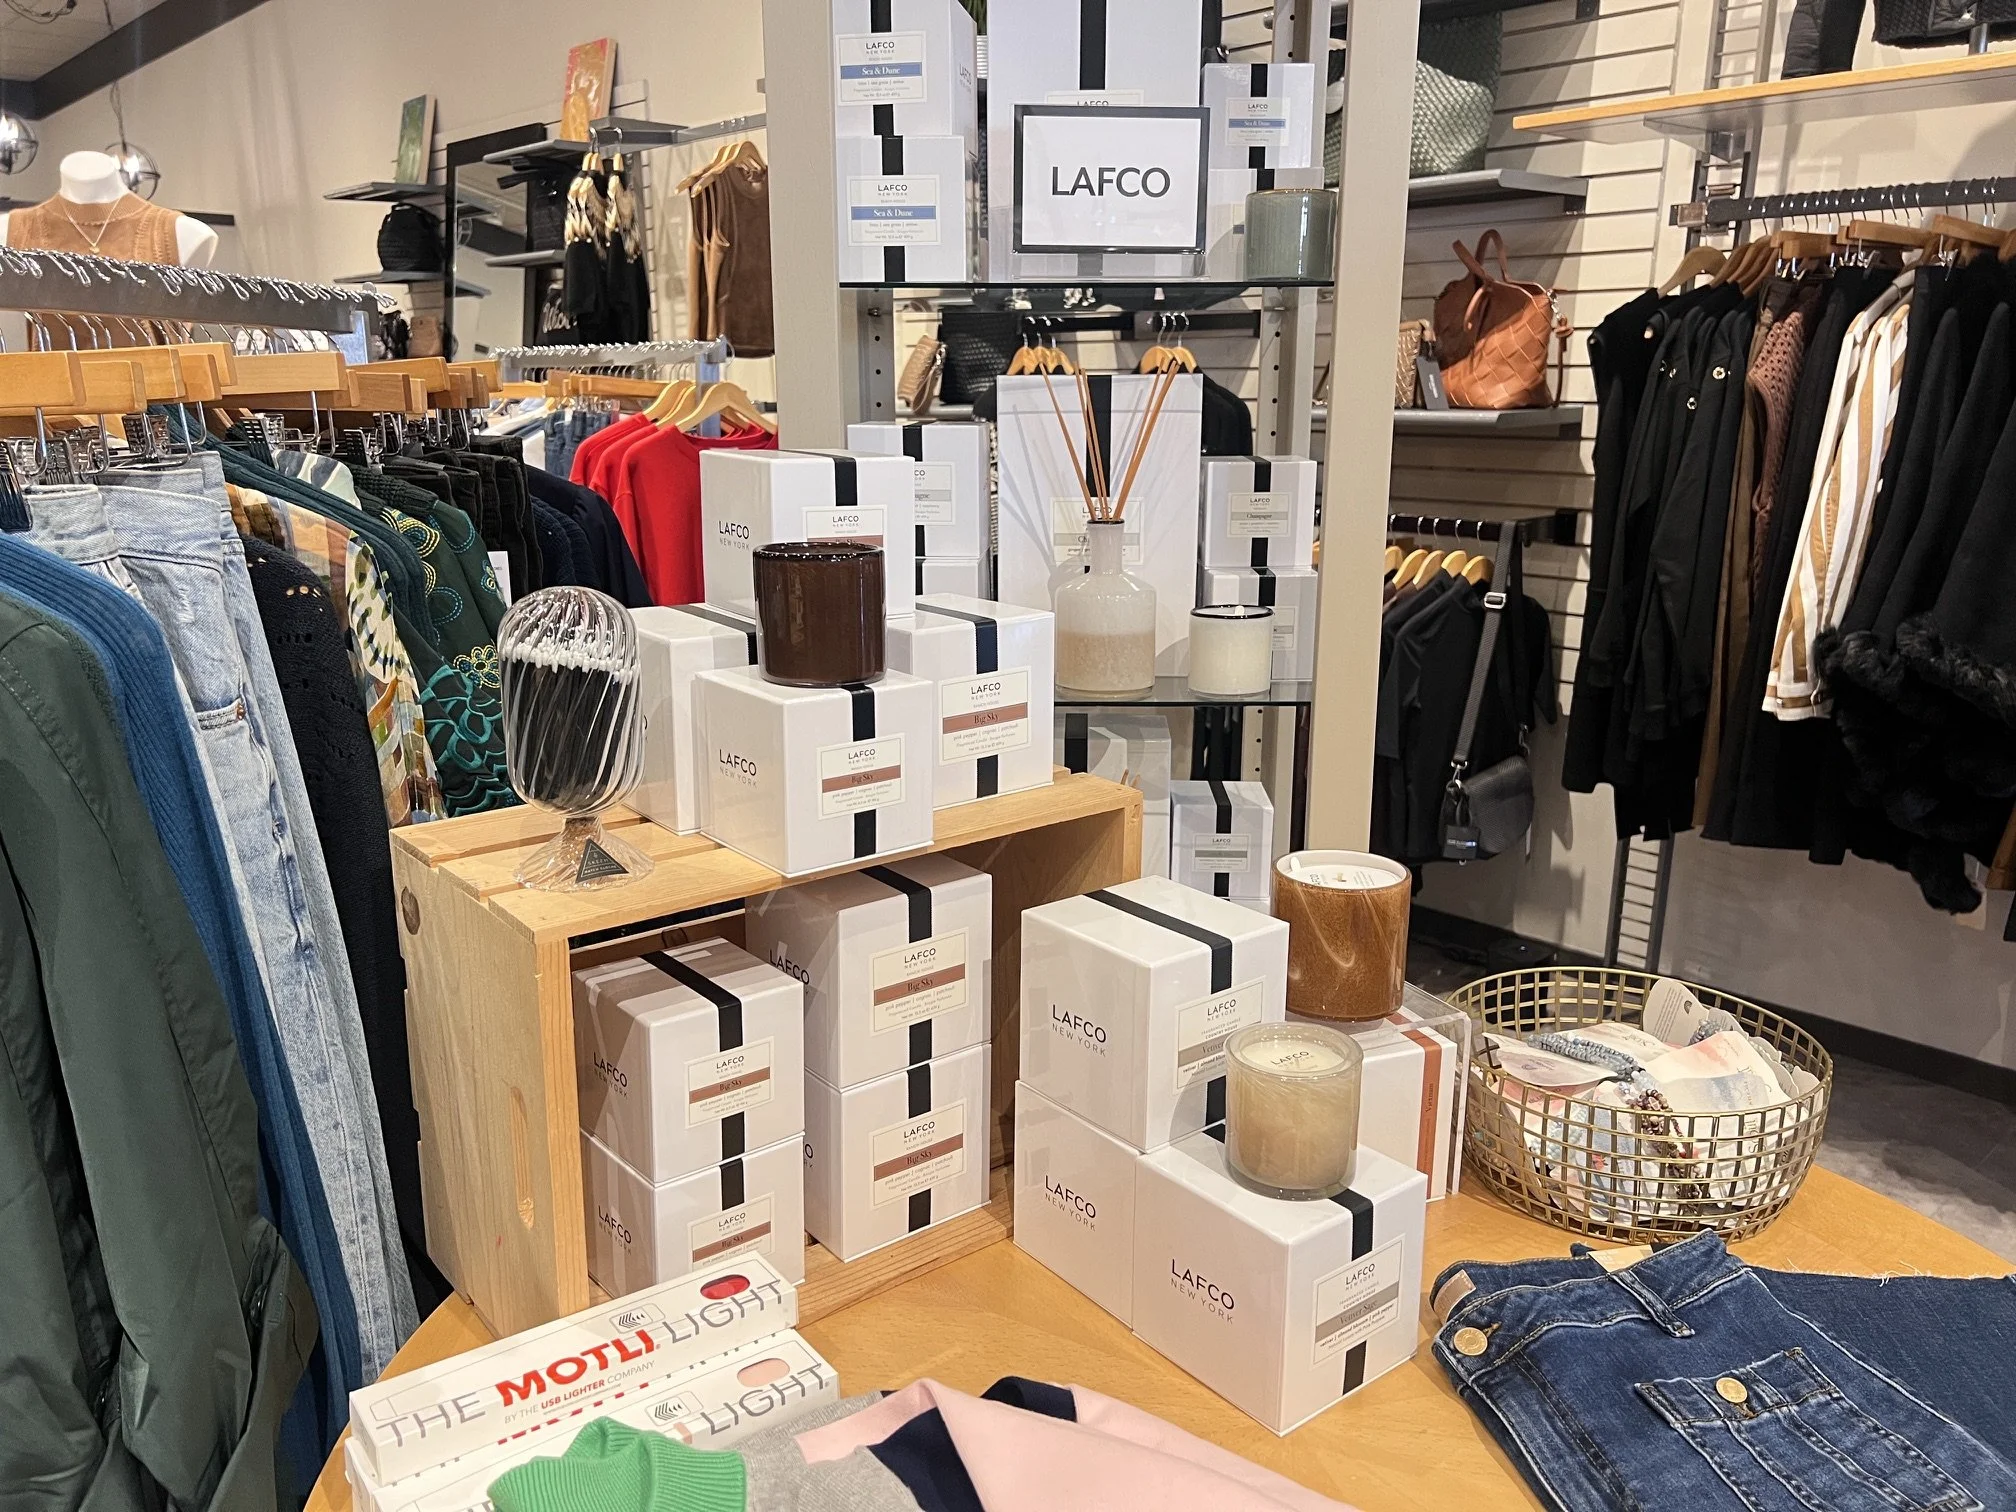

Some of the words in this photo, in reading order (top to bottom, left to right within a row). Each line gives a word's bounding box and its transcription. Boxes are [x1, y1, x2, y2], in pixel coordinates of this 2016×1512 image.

[866, 41, 895, 50] LAFCO
[862, 67, 874, 76] Sea
[882, 66, 901, 75] Dune
[1052, 166, 1171, 198] LAFCO
[873, 209, 886, 217] Sea
[894, 208, 913, 217] Dune
[832, 515, 860, 523] LAFCO
[719, 520, 749, 540] LAFCO
[720, 537, 731, 546] NEW
[733, 541, 749, 550] YORK
[971, 682, 1001, 695] LAFCO
[974, 715, 986, 725] Big
[986, 712, 998, 722] Sky
[720, 748, 757, 776] LAFCO
[848, 749, 876, 760] LAFCO
[720, 766, 735, 778] NEW
[738, 774, 758, 788] YORK
[904, 948, 936, 964] LAFCO
[769, 949, 810, 985] LAFCO
[907, 982, 920, 992] Big
[922, 979, 933, 987] Sky
[1207, 999, 1237, 1016] LAFCO
[1052, 1004, 1106, 1043] LAFCO
[1052, 1023, 1074, 1040] NEW
[1078, 1036, 1106, 1058] YORK
[716, 1055, 744, 1069] LAFCO
[1271, 1050, 1309, 1065] LAFCO
[594, 1051, 628, 1088] LAFCO
[904, 1121, 936, 1138] LAFCO
[906, 1156, 920, 1166] Big
[920, 1151, 932, 1159] Sky
[1046, 1174, 1096, 1218] LAFCO
[718, 1212, 746, 1228] LAFCO
[1045, 1193, 1066, 1212] NEW
[1069, 1208, 1096, 1232] YORK
[598, 1204, 632, 1244] LAFCO
[1172, 1258, 1234, 1310] LAFCO
[1346, 1263, 1376, 1285] LAFCO
[1170, 1278, 1196, 1300] NEW
[1200, 1297, 1234, 1324] YORK
[376, 1392, 486, 1448] THE
[495, 1329, 655, 1407] MOTLI
[662, 1278, 782, 1344] LIGHT
[504, 1411, 518, 1424] BY
[518, 1405, 539, 1418] THE
[541, 1396, 561, 1410] USB
[563, 1379, 606, 1401] LIGHTER
[606, 1360, 656, 1384] COMPANY
[700, 1362, 824, 1436] LIGHT
